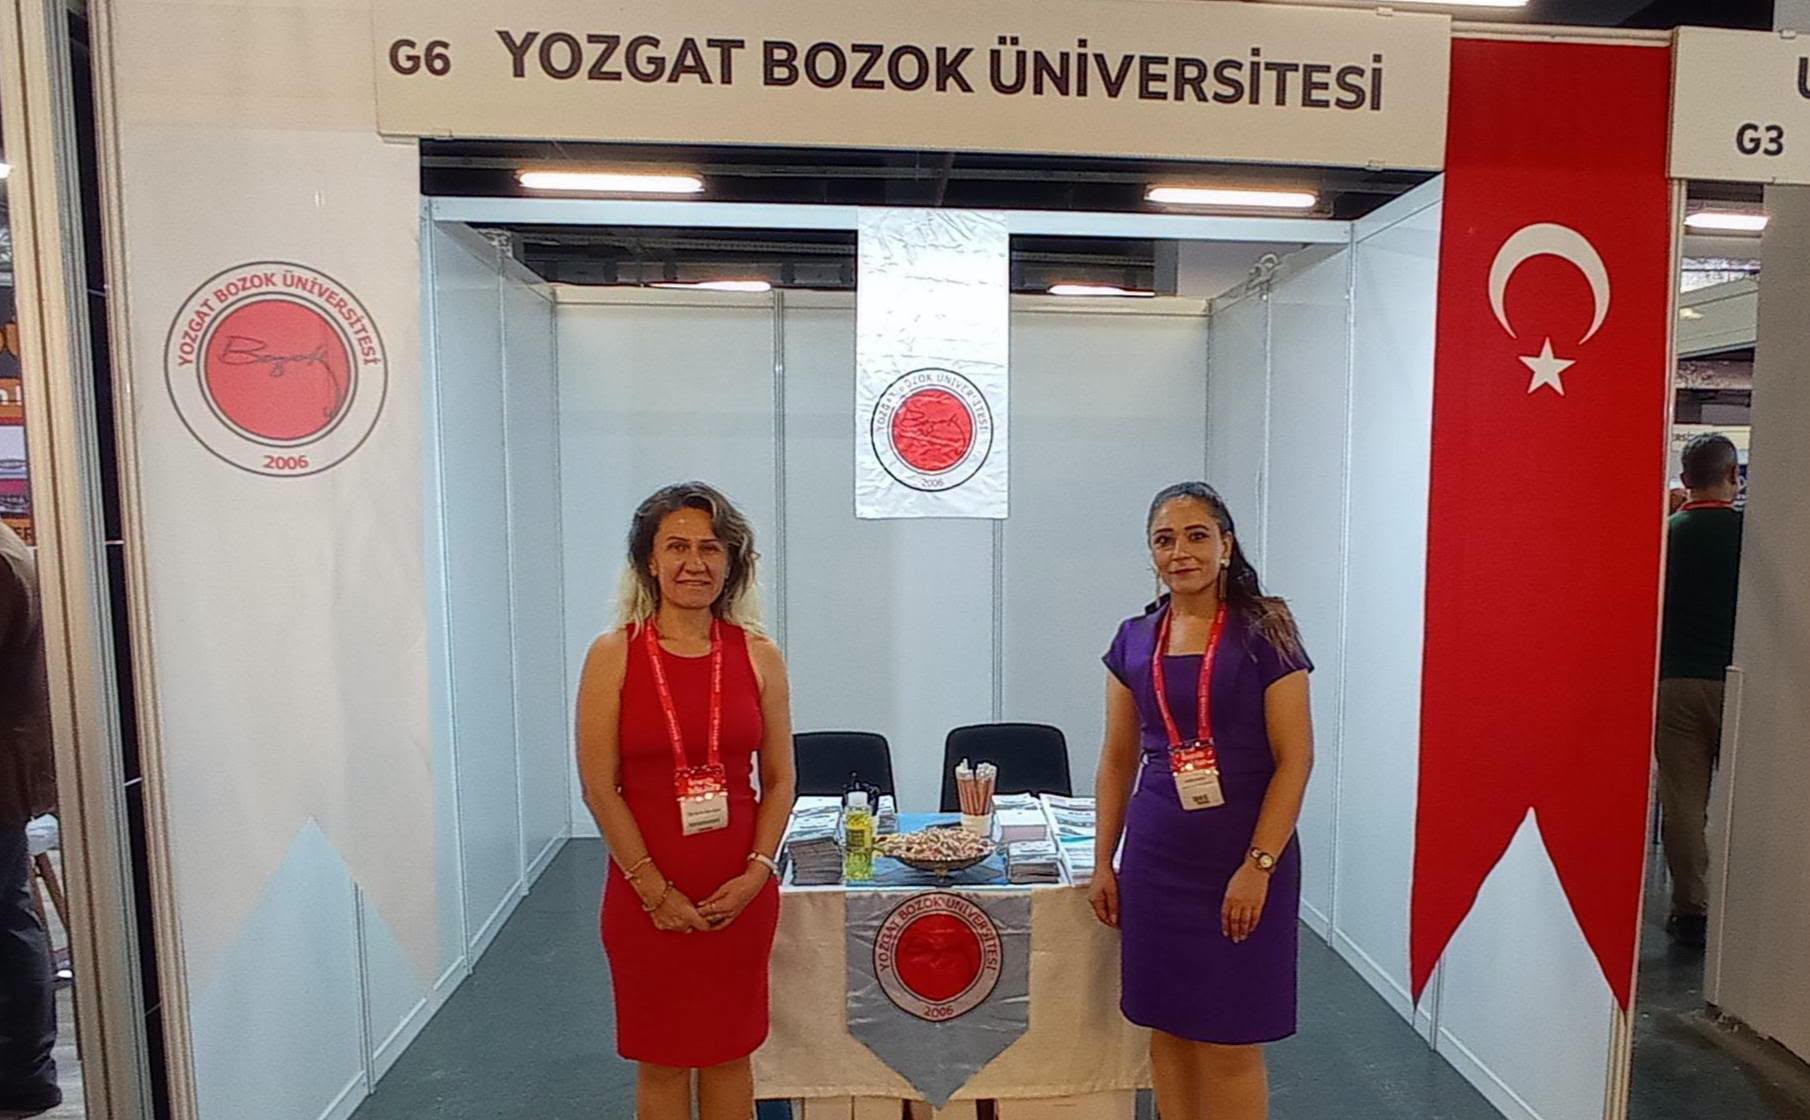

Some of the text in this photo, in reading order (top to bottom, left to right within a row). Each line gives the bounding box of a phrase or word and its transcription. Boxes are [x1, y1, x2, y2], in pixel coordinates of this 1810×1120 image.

[388, 39, 452, 76] G6
[496, 30, 1384, 112] YOZGAT BOZOK ÜNİVERSİTESİ
[1736, 122, 1785, 157] G3
[178, 269, 381, 367] YOZGAT BOZOK ÜNİVERSİTESİ
[263, 454, 310, 471] 2006
[878, 920, 900, 972] YOZGAT
[897, 896, 946, 920] BOZOK
[923, 1005, 954, 1019] 2006
